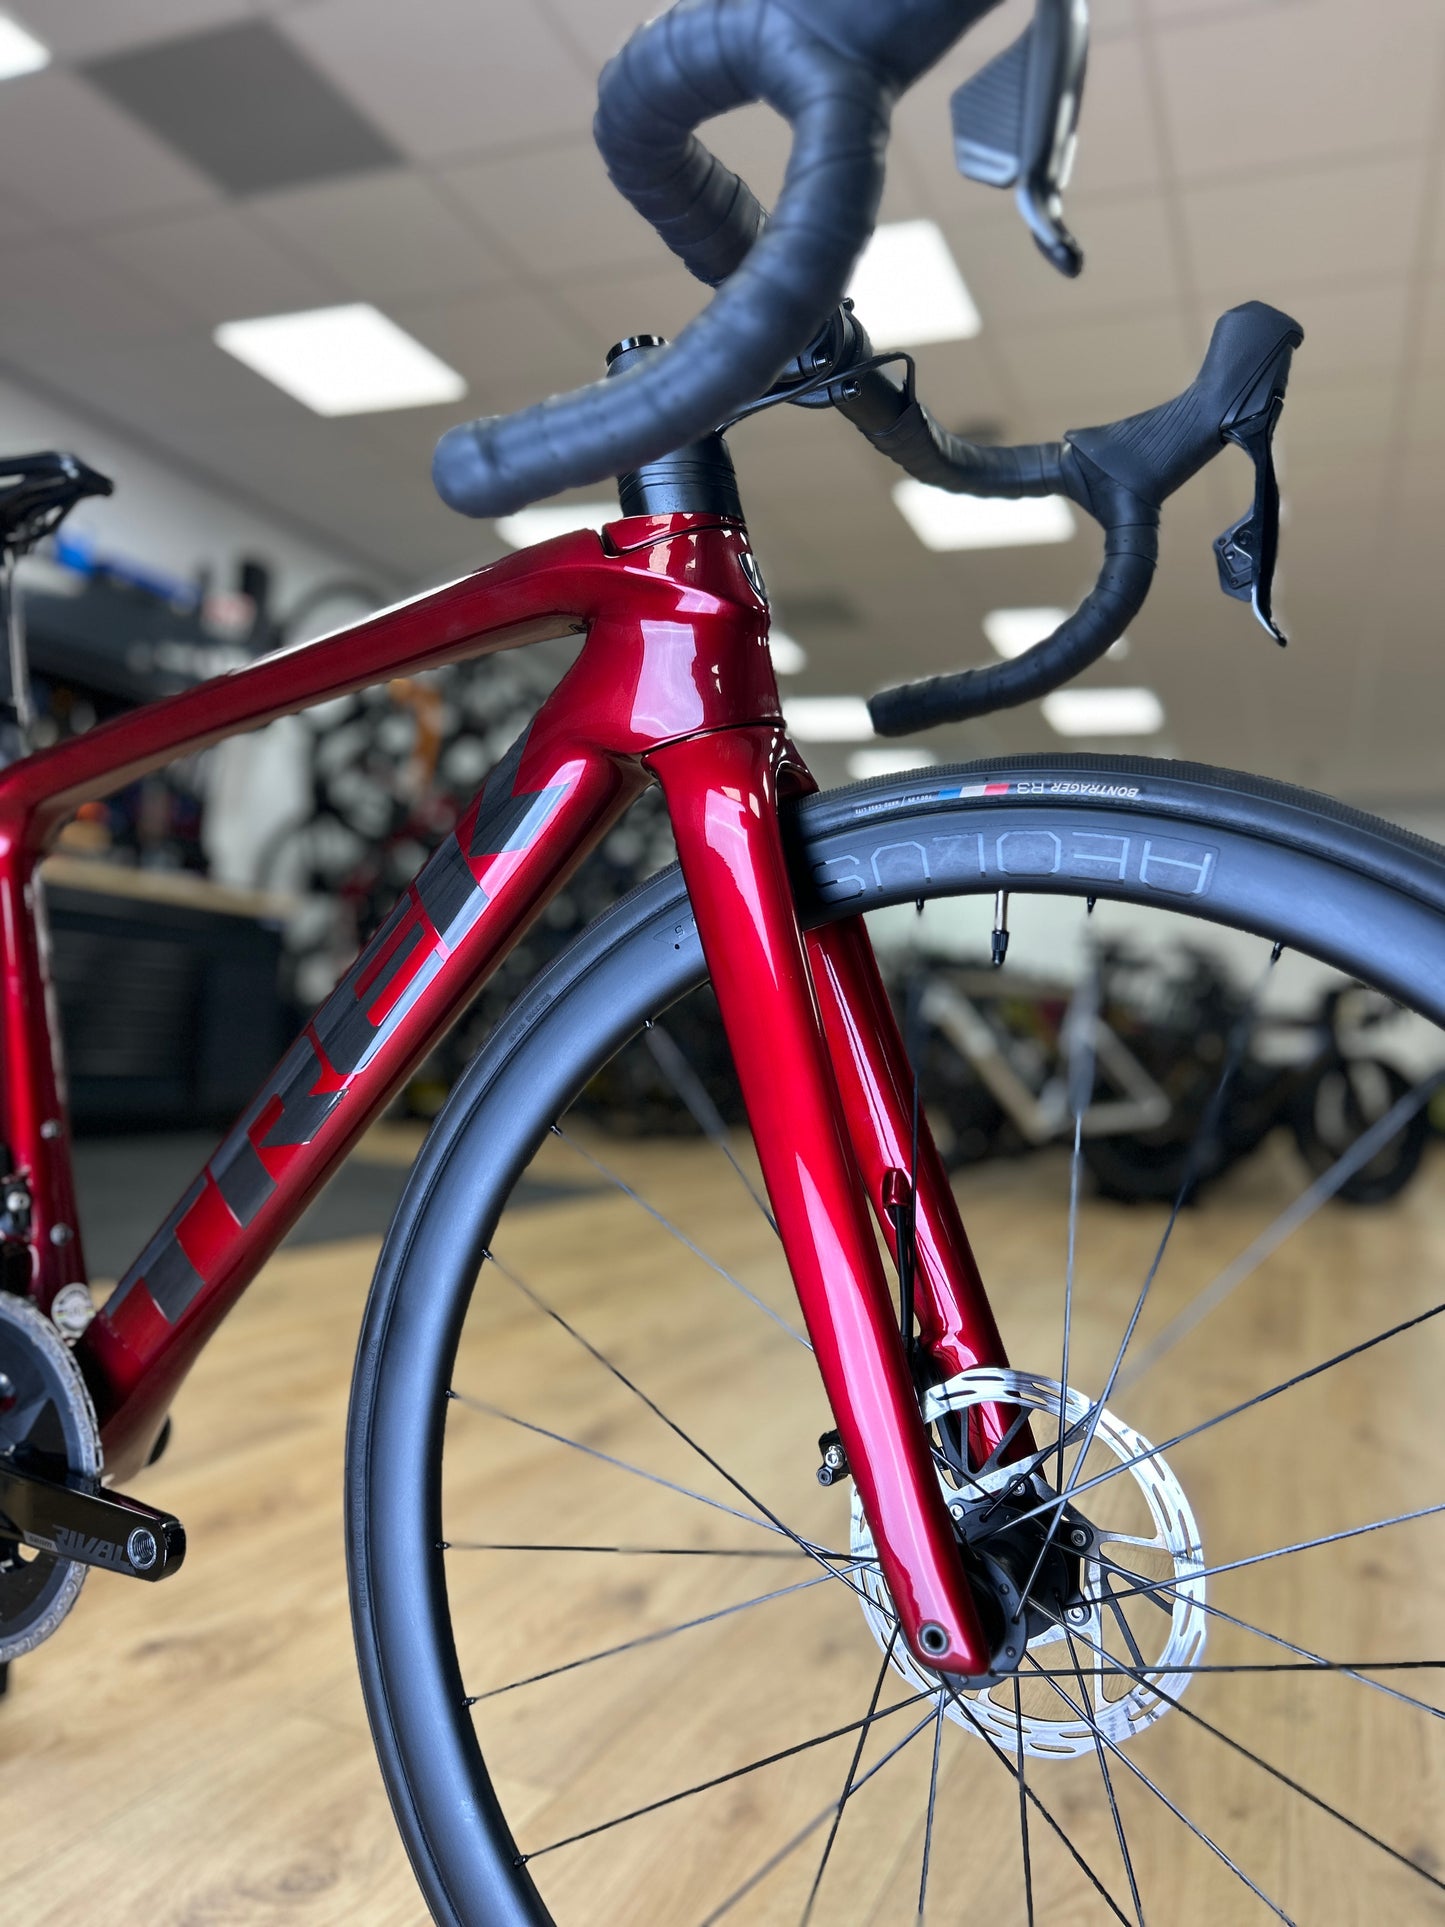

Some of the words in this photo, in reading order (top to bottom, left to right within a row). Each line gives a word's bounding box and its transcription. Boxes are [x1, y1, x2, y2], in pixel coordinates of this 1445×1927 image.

[1017, 781, 1043, 794] R3
[1050, 782, 1139, 798] BONTRAGER
[812, 830, 1213, 905] AEOLUS
[104, 712, 571, 1325] TREK
[52, 1523, 129, 1564] RIVAL
